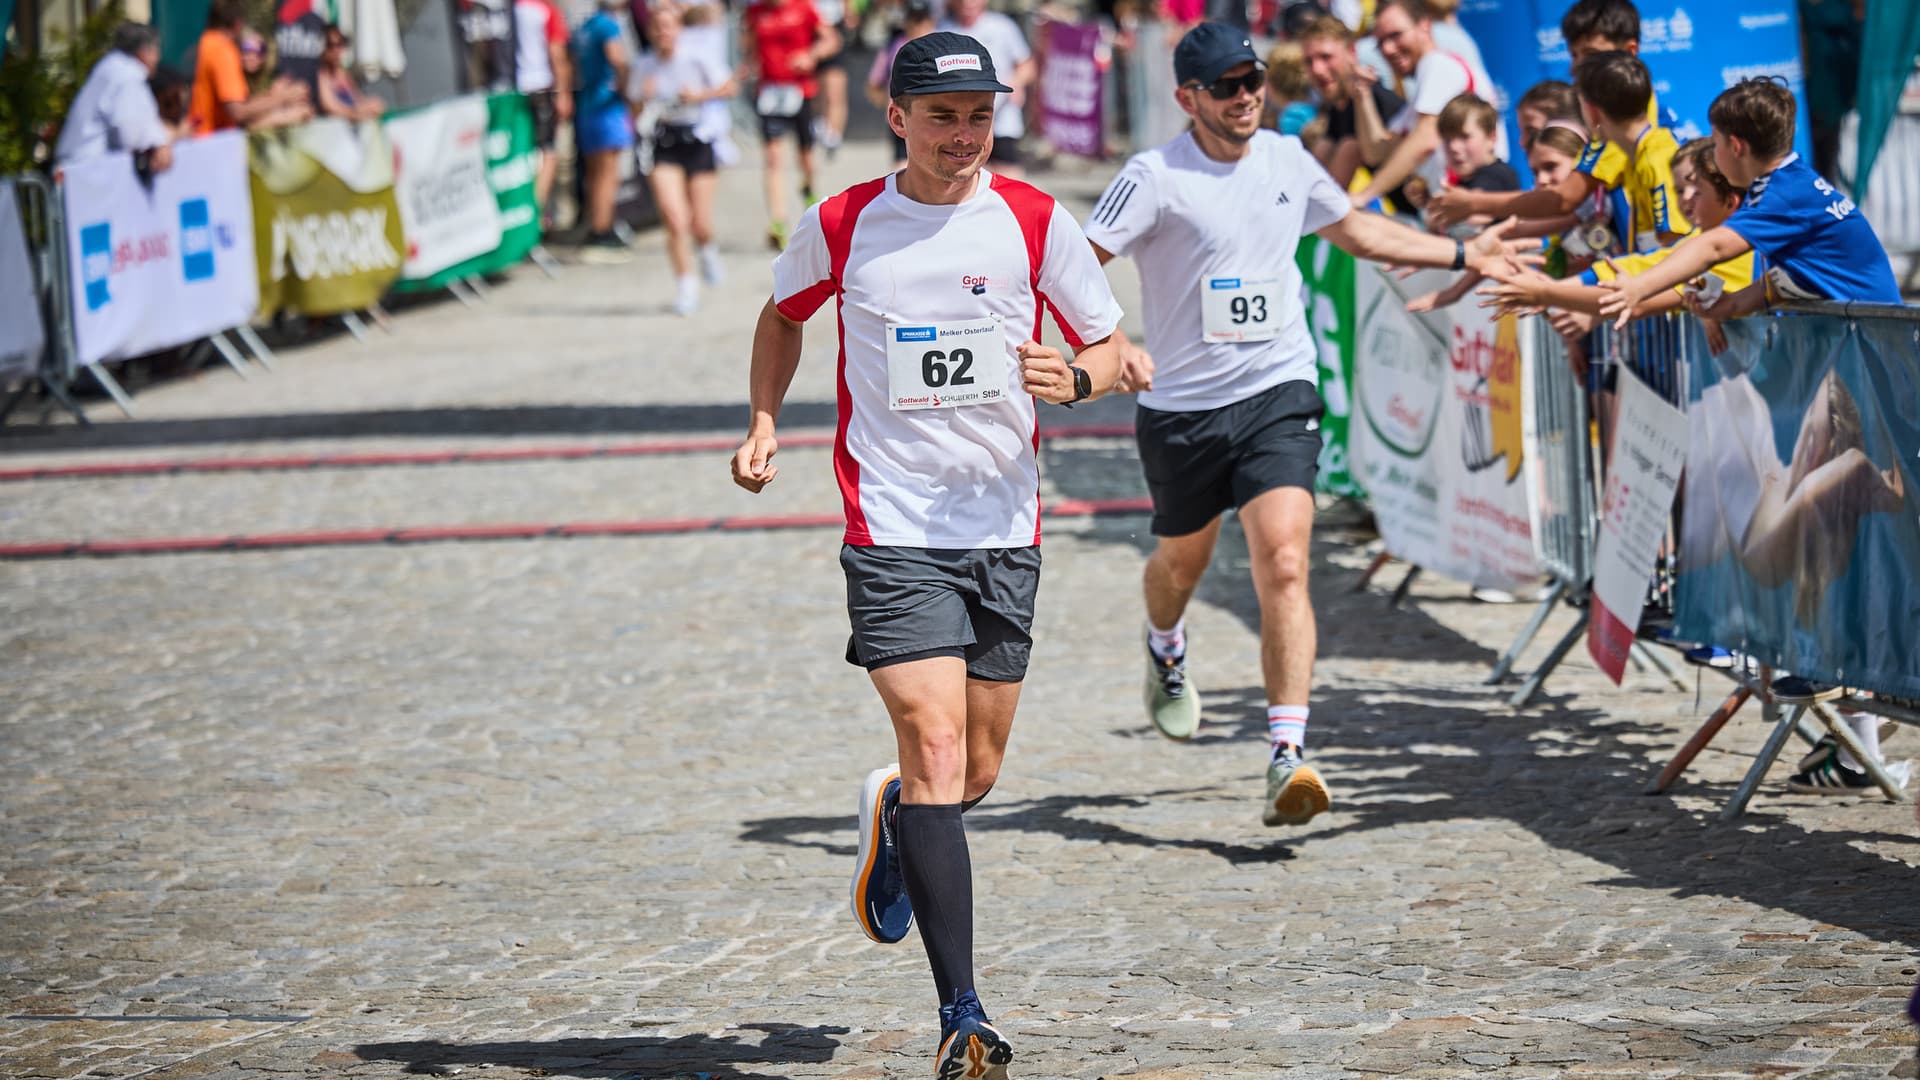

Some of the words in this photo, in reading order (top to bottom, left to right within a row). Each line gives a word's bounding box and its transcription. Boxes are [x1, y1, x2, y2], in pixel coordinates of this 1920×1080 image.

[940, 58, 977, 67] Gottwald
[1230, 295, 1267, 324] 93
[940, 329, 963, 337] Melker
[964, 326, 994, 335] Osterlauf
[922, 348, 974, 387] 62
[898, 396, 929, 404] Gottwald
